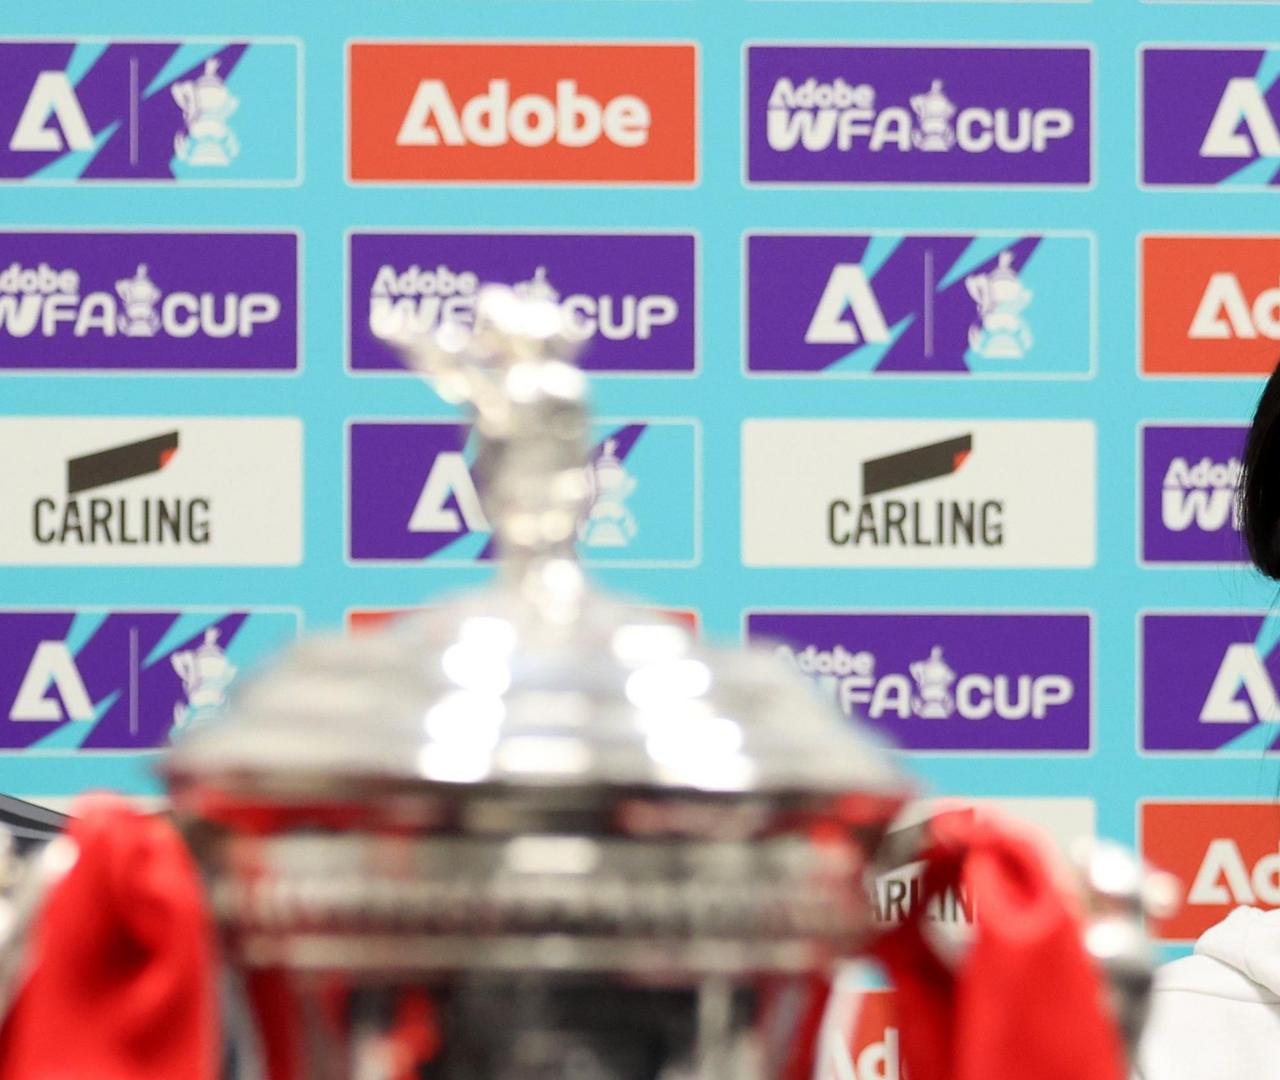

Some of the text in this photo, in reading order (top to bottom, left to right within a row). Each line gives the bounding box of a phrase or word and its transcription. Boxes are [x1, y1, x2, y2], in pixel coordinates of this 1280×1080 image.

[398, 80, 650, 146] Adobe
[769, 79, 874, 107] Adobe
[960, 108, 1072, 152] CUP
[372, 265, 478, 295] Adobe
[166, 293, 279, 337] CUP
[34, 499, 209, 543] CARLING
[829, 500, 1002, 546] CARLING
[840, 674, 1072, 719] FA CUP
